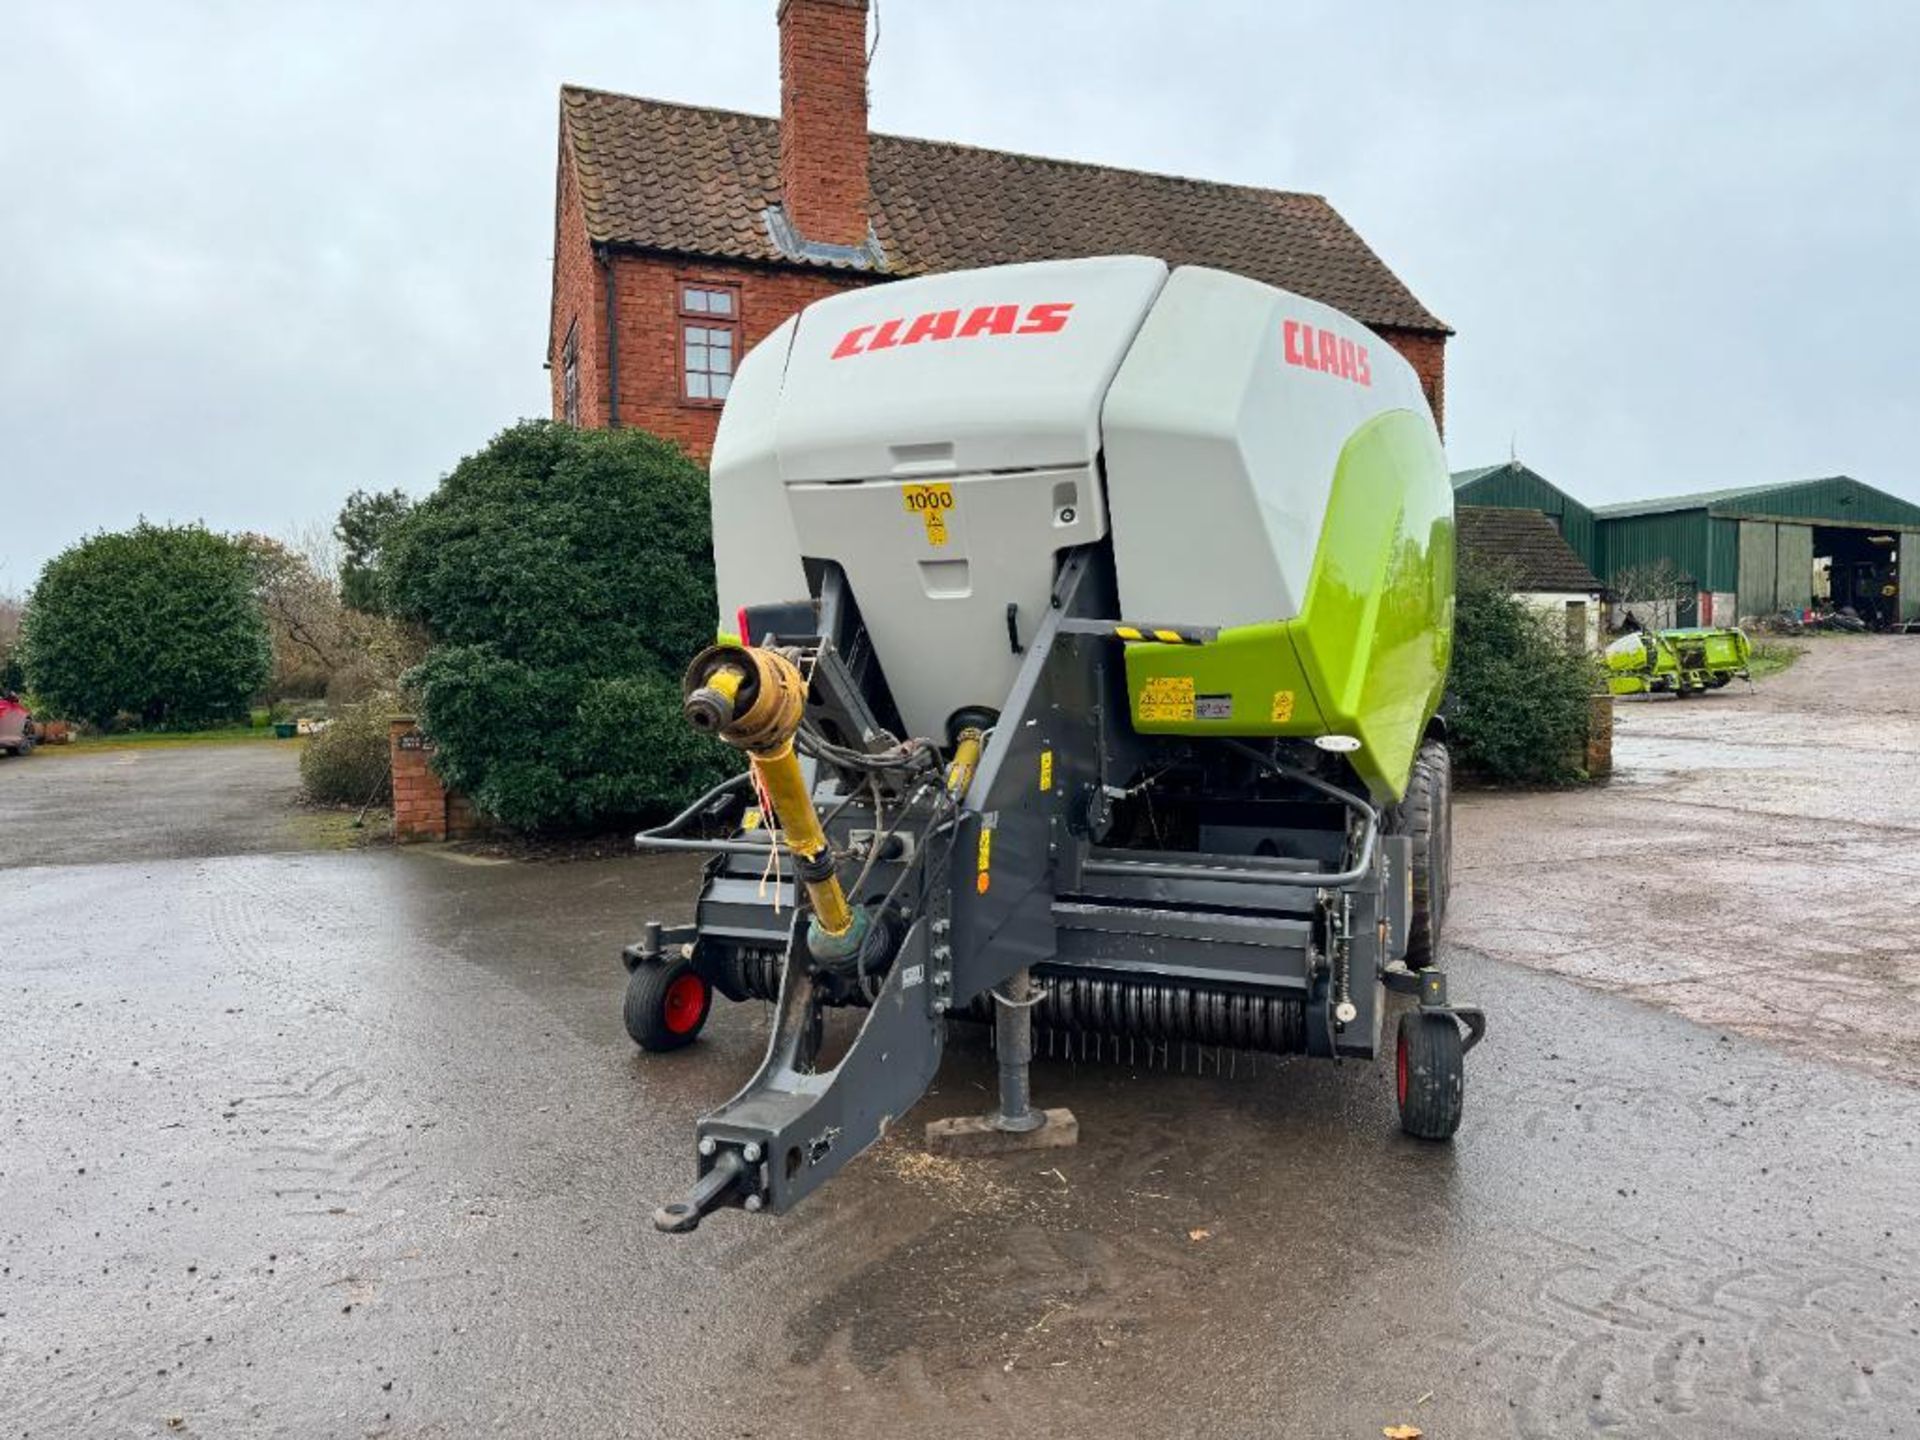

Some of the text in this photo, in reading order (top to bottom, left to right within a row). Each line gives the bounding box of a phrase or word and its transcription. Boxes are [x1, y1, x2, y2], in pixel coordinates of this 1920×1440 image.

[831, 303, 1075, 360] CLAAS
[1283, 320, 1371, 386] CLAAS
[907, 491, 952, 509] 1000
